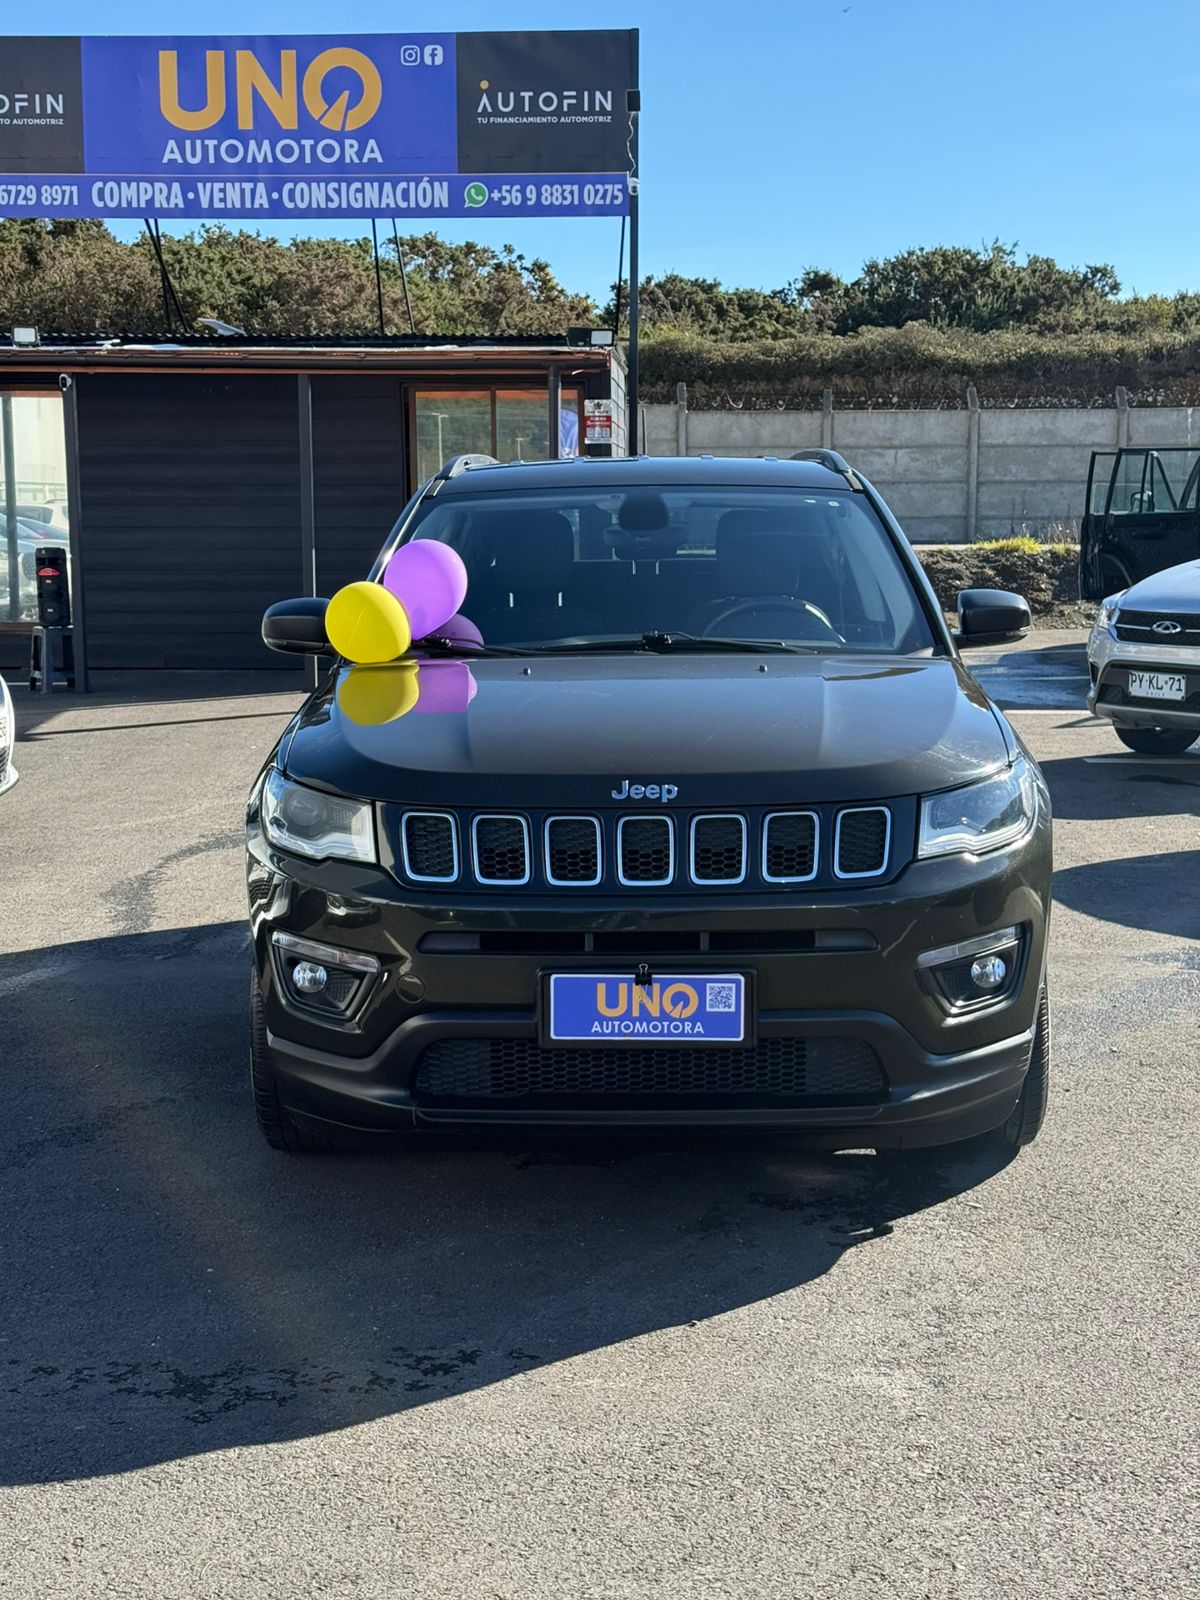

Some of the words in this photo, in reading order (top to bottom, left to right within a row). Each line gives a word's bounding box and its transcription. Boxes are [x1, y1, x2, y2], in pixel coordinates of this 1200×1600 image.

[158, 47, 382, 131] UNO
[477, 90, 612, 113] AUTOFIN
[490, 116, 558, 124] FINANCIAMIENTO
[162, 138, 384, 164] AUTOMOTORA
[0, 185, 37, 205] 6729
[41, 185, 78, 206] 8971
[491, 185, 522, 206] +56
[526, 185, 537, 206] 9
[541, 185, 579, 206] 8831
[583, 184, 623, 205] 0275
[611, 779, 678, 803] Jeep
[596, 982, 699, 1019] UNO
[591, 1020, 704, 1034] AUTOMOTORA
